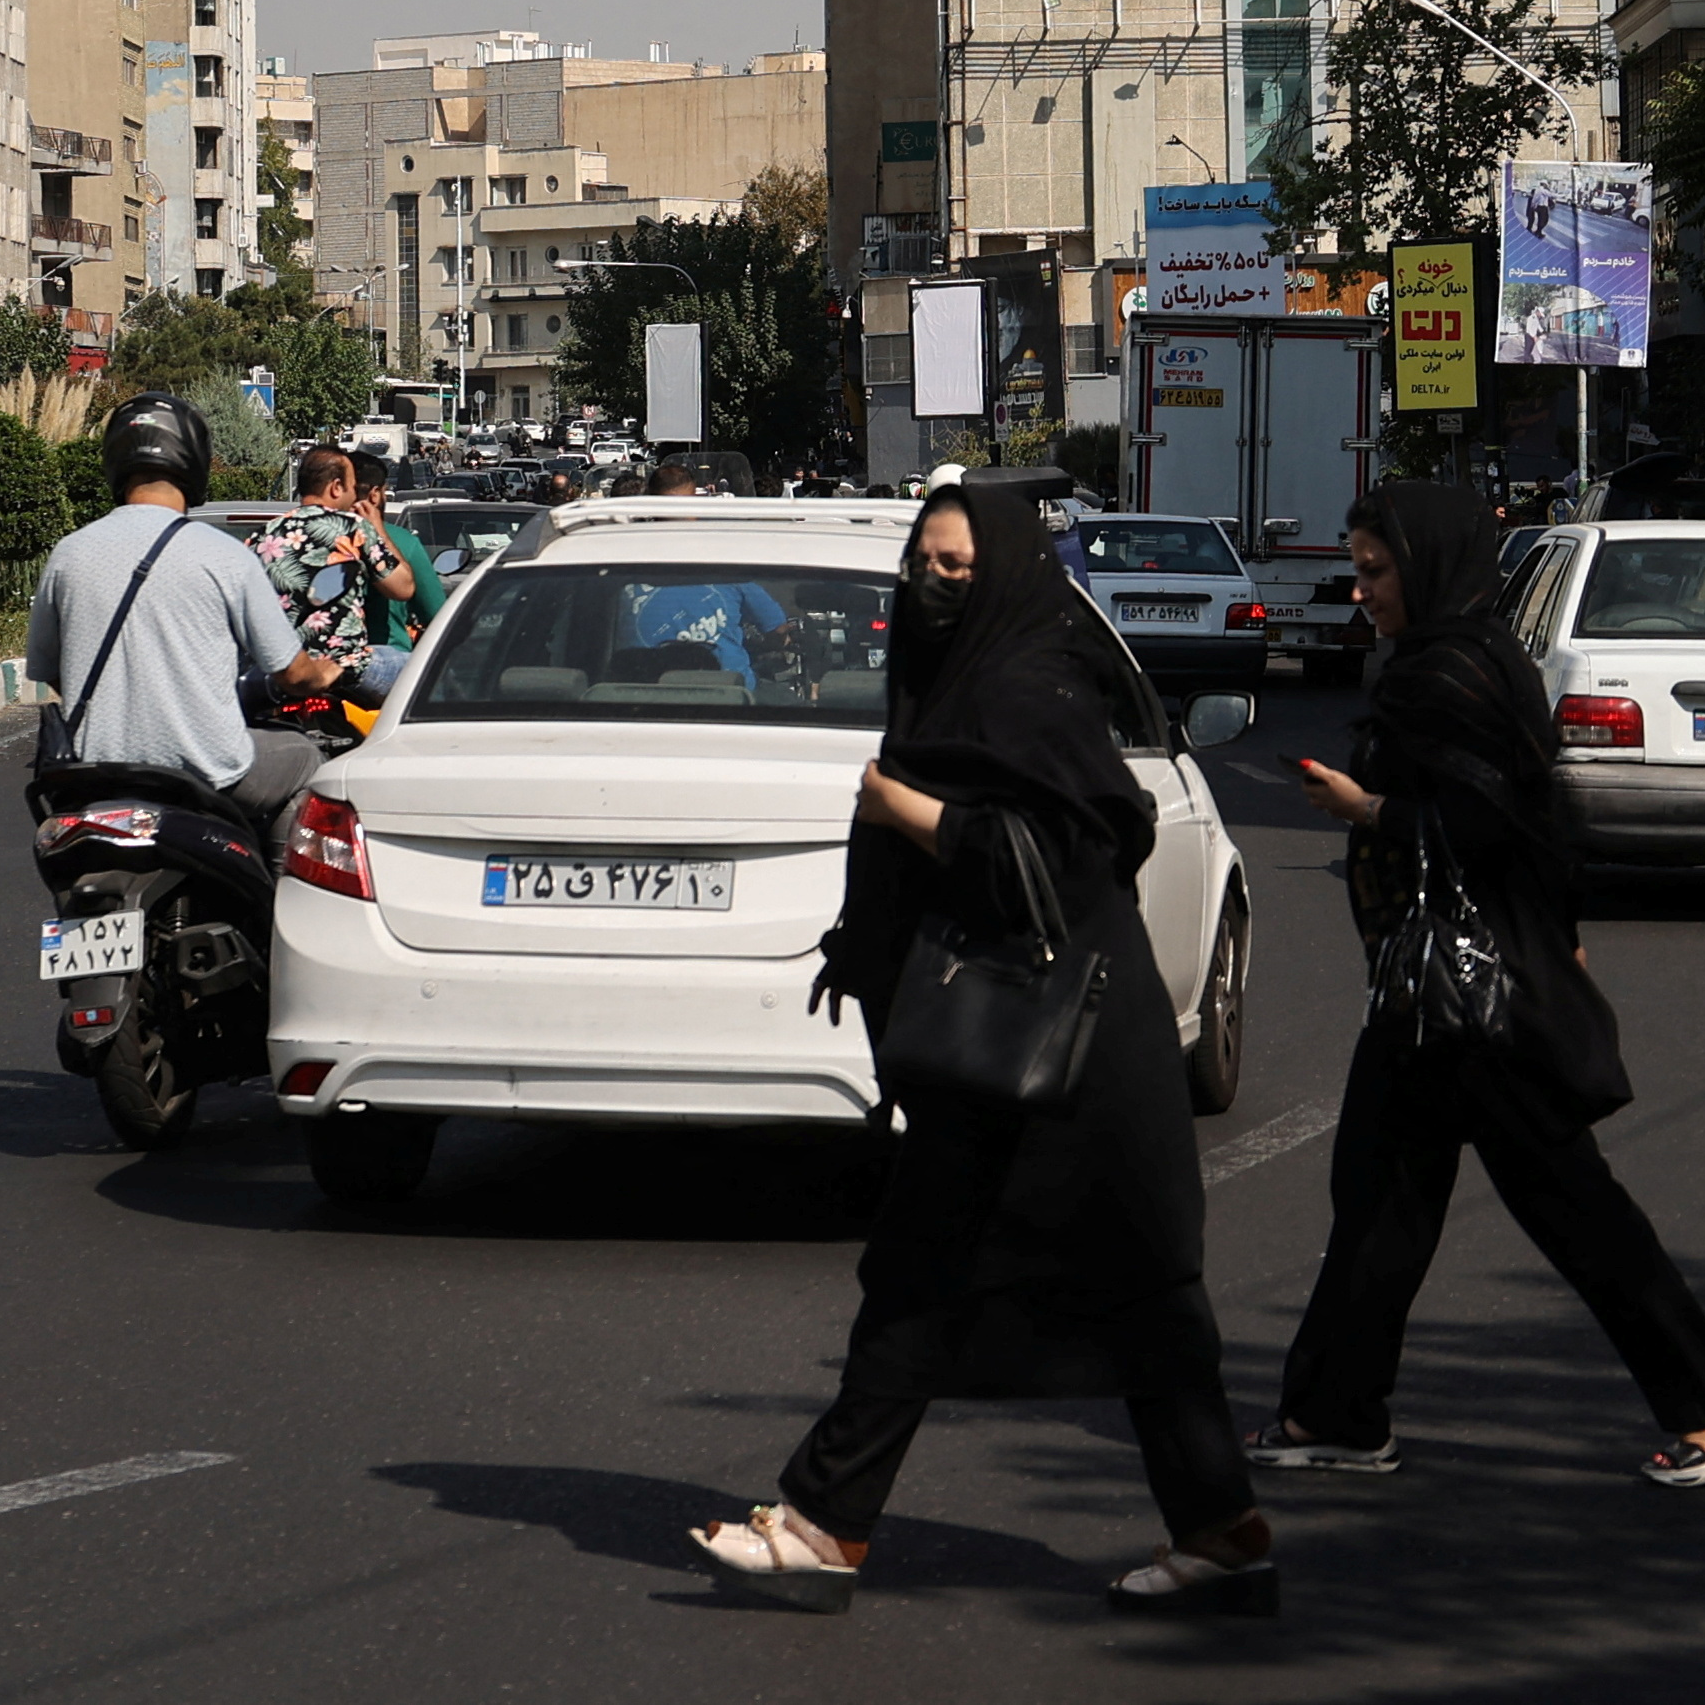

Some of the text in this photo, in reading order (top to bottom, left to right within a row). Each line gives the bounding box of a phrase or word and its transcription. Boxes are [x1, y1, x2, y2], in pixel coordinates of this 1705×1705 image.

[1203, 197, 1232, 214] باید
[1159, 252, 1213, 278] تخفیف
[1418, 259, 1453, 279] خونه
[1583, 257, 1613, 269] مردم
[1508, 267, 1541, 278] مردم
[1161, 283, 1211, 310] رایگان
[1214, 284, 1255, 308] حمل
[1441, 282, 1468, 298] دنبال
[1402, 311, 1461, 341] دلتا
[1399, 349, 1465, 361] اولین سایت ملکی
[1422, 361, 1442, 373] ایران
[1411, 384, 1451, 394] DELTA.ir
[1266, 607, 1304, 617] SARD
[512, 862, 554, 899] ۲۵
[606, 863, 674, 900] ۴۷۶
[79, 917, 126, 944] ۱۵۷
[48, 944, 134, 975] ۴۸۱۷۲
